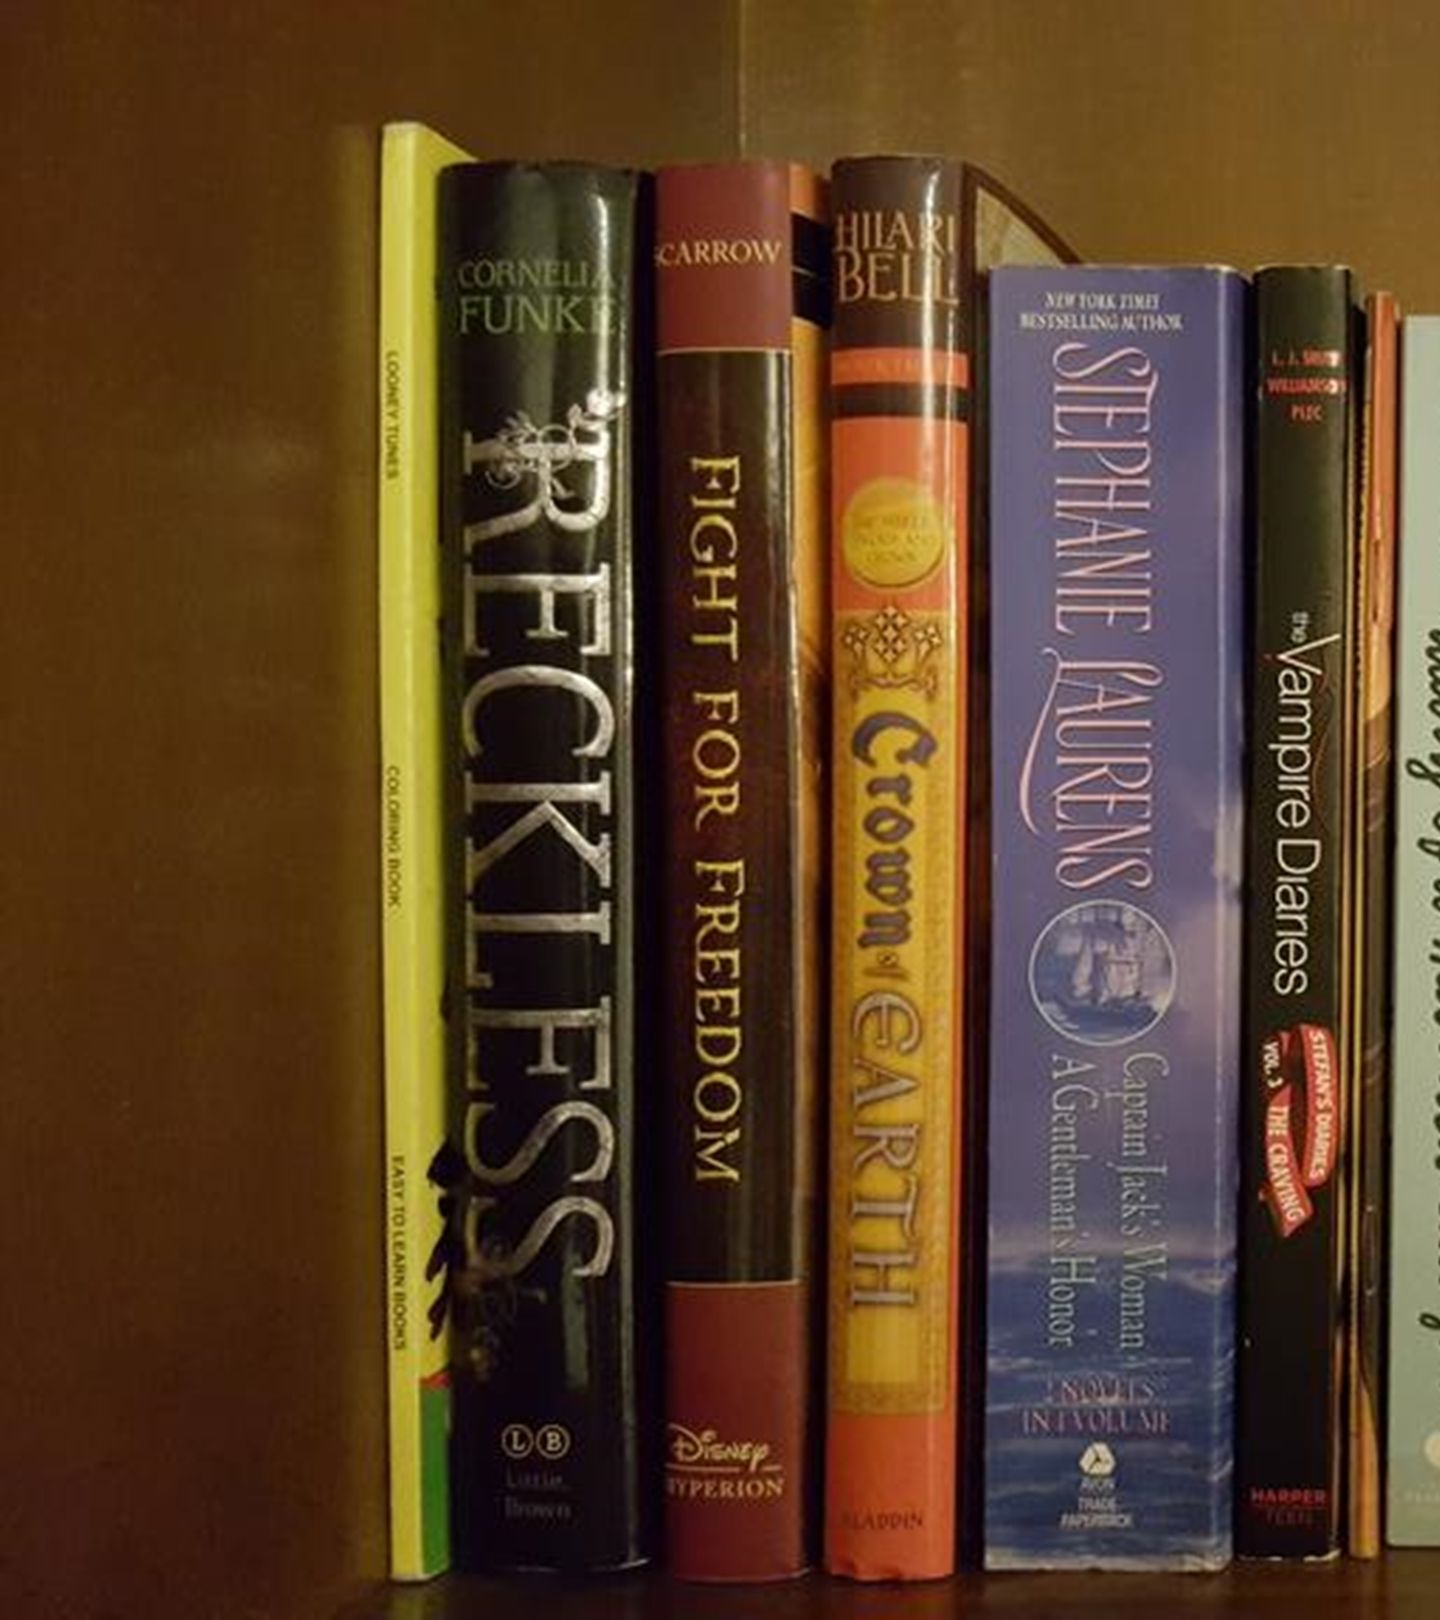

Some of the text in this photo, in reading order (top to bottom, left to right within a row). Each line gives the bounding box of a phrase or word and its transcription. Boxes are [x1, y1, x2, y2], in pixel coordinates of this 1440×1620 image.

[458, 258, 616, 289] CORNELIA
[835, 211, 956, 253] HILARI
[837, 249, 960, 303] BELL
[459, 293, 616, 335] FUNKE
[1019, 312, 1183, 332] BESTSELLING AUTHOR
[1044, 291, 1076, 309] NEW
[1078, 292, 1117, 310] YORK
[385, 350, 400, 480] LOONEY TUNES
[1019, 341, 1164, 890] STEPHANIE LAURENS
[386, 765, 402, 908] COLORING BOOK
[462, 428, 616, 1278] RECKLESS
[690, 456, 745, 1184] FIGHT FOR FREEDOM
[851, 710, 938, 952] Crown
[1268, 611, 1342, 996] the Vampire Diaries
[1263, 1041, 1281, 1075] VOL.
[1309, 1029, 1332, 1180] STEFAN'S DIARIES
[850, 990, 924, 1310] EARTH
[1047, 1052, 1099, 1349] A Gentleman's Honor
[1103, 1050, 1170, 1349] Captain Jack's Woman
[1267, 1105, 1306, 1223] THE CRAVING
[392, 1156, 408, 1350] EASY TO LEARN BOOKS
[667, 1422, 771, 1473] Disney
[1022, 1409, 1051, 1433] IN
[1069, 1409, 1170, 1434] VOLUME
[1251, 1487, 1327, 1504] HARPER
